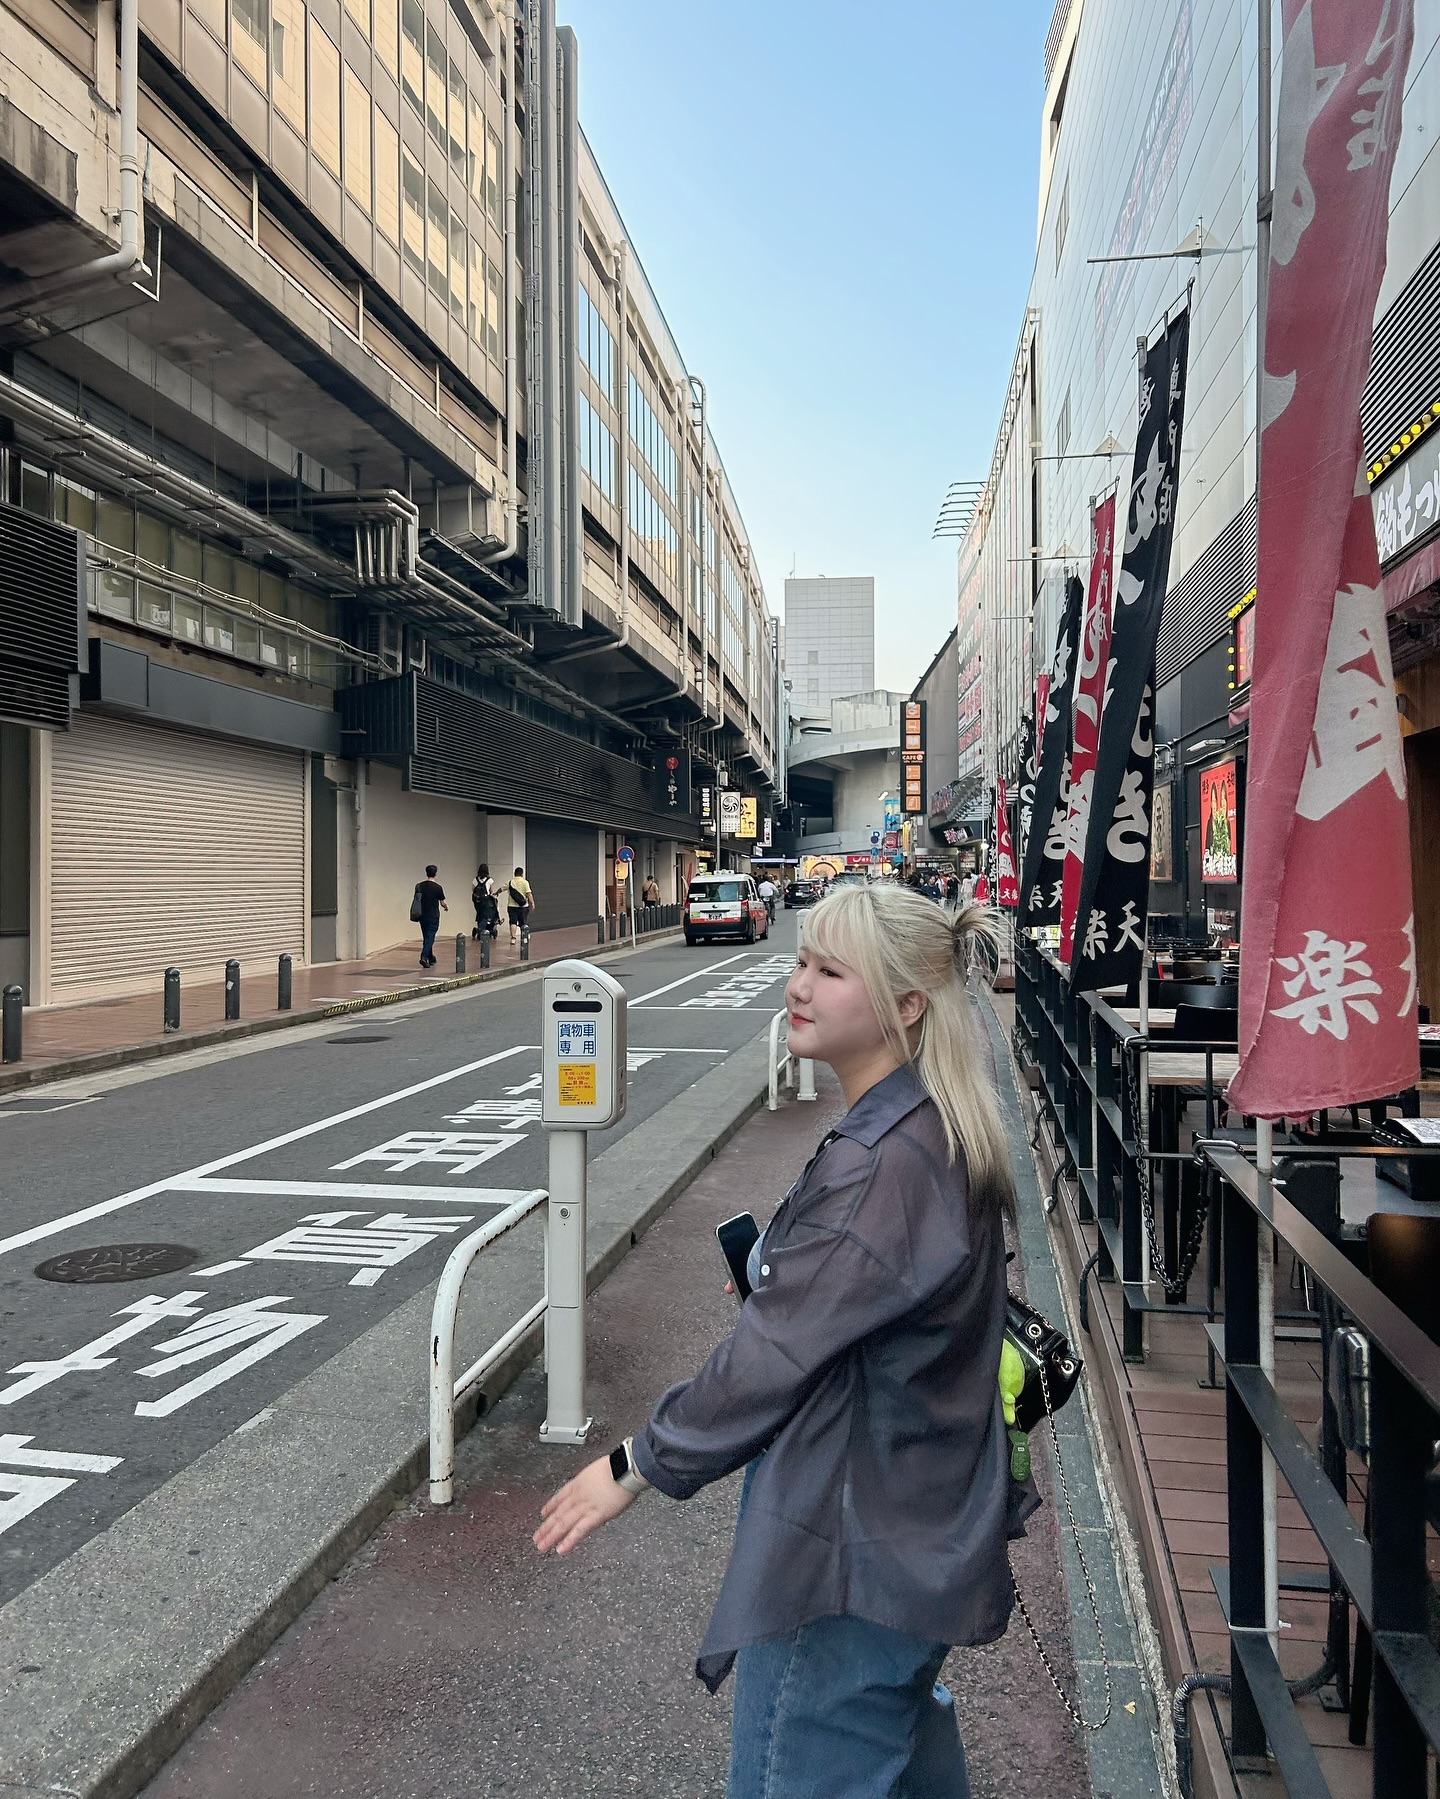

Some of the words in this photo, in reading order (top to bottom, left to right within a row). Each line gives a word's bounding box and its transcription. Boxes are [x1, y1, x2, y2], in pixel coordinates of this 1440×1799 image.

[560, 1024, 594, 1038] 貨物車
[560, 1041, 594, 1054] 専用
